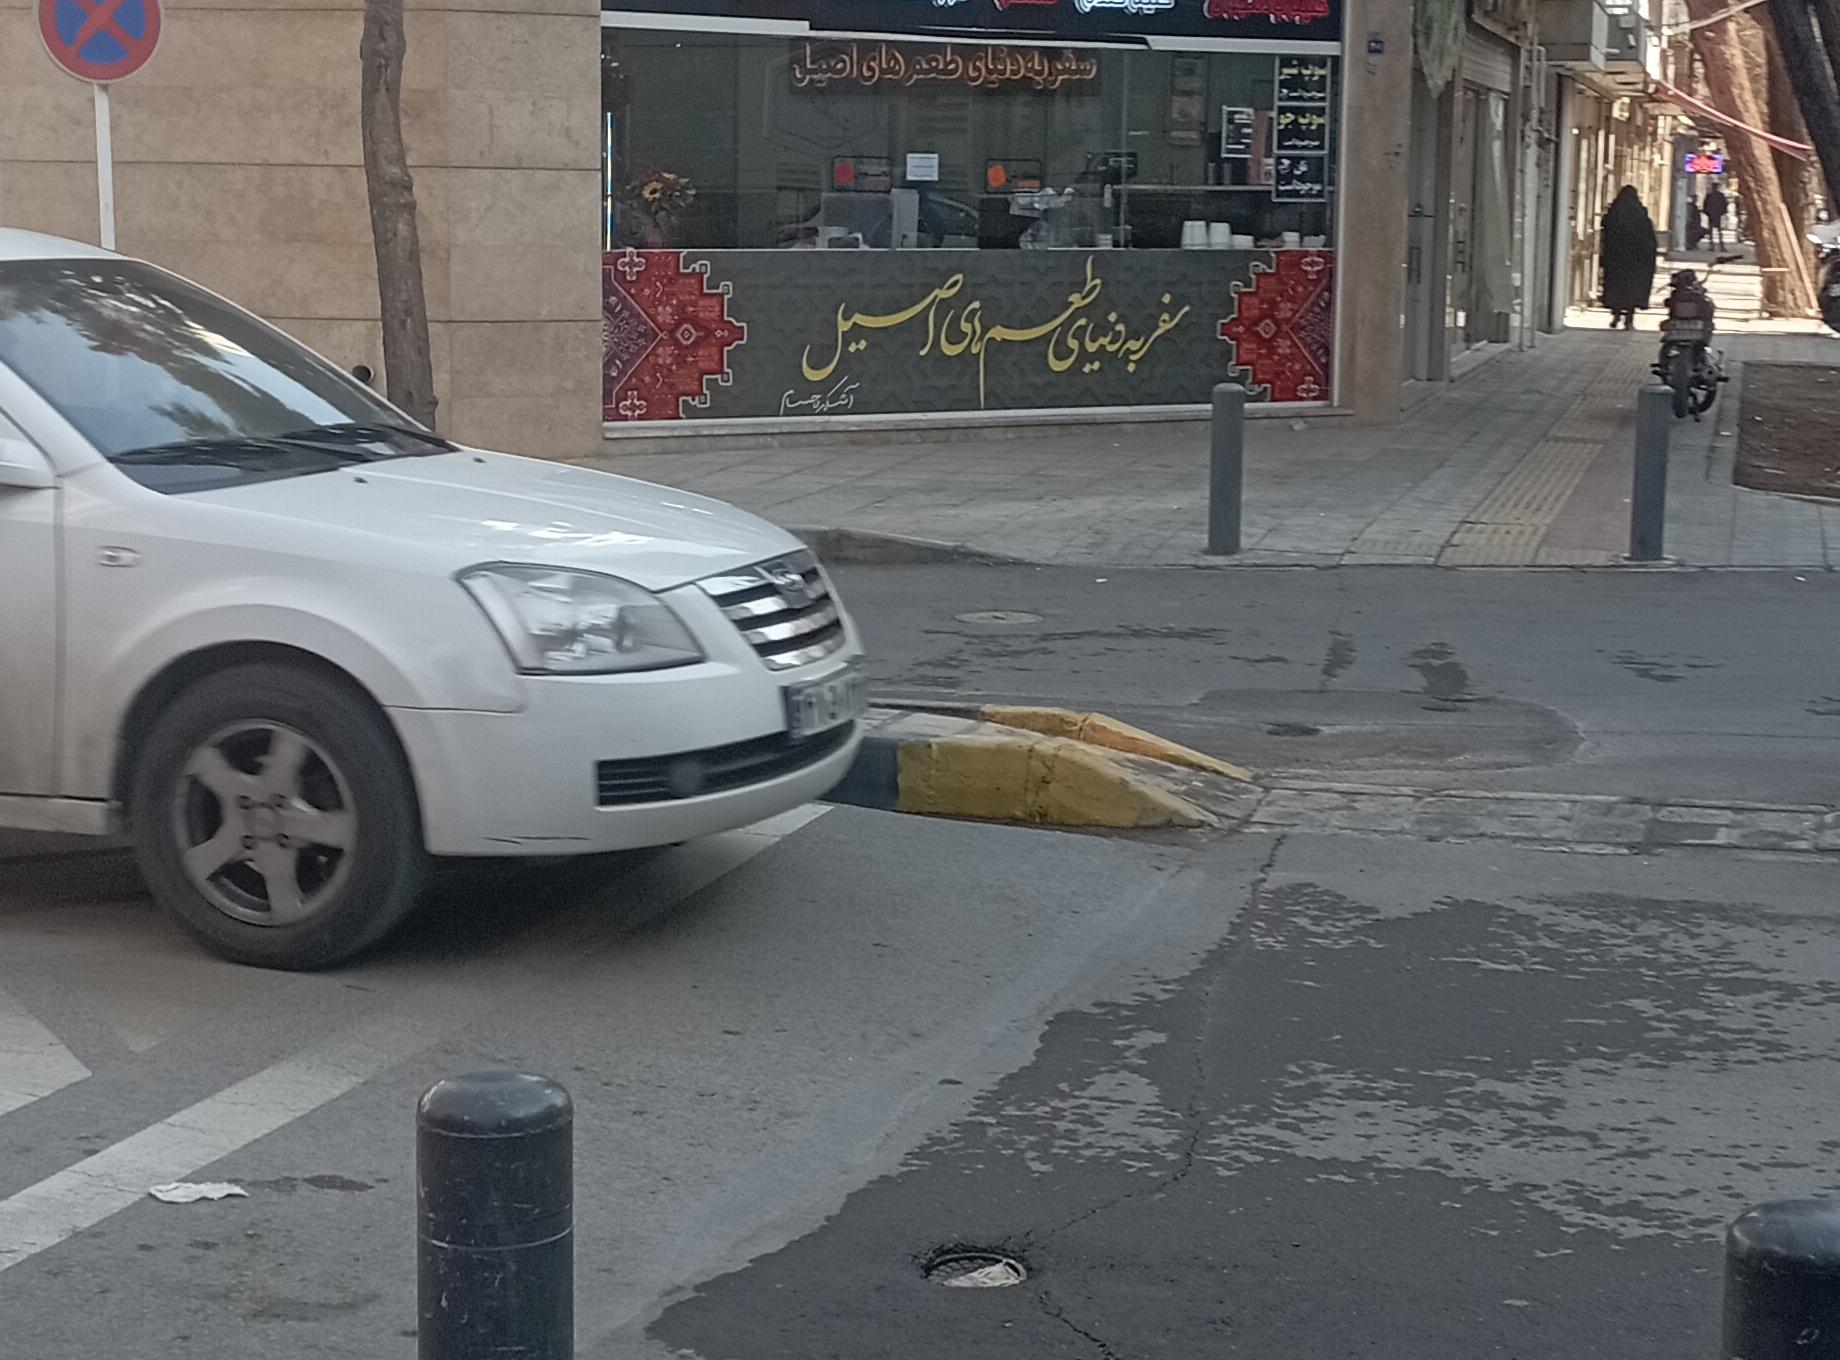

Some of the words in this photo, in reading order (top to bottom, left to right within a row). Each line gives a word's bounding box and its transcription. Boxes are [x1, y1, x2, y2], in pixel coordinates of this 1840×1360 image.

[792, 42, 858, 87] اصیل
[858, 42, 905, 86] های
[904, 43, 963, 87] طعم
[967, 44, 1026, 87] دنیای
[1025, 48, 1050, 89] به
[1046, 48, 1097, 89] سفر
[801, 272, 965, 382] اصیل
[940, 300, 984, 357] های
[979, 254, 1102, 410] طعم
[1047, 311, 1126, 374] دنیای
[1128, 292, 1192, 361] سفر
[1117, 336, 1147, 374] به
[779, 389, 822, 417] حسام
